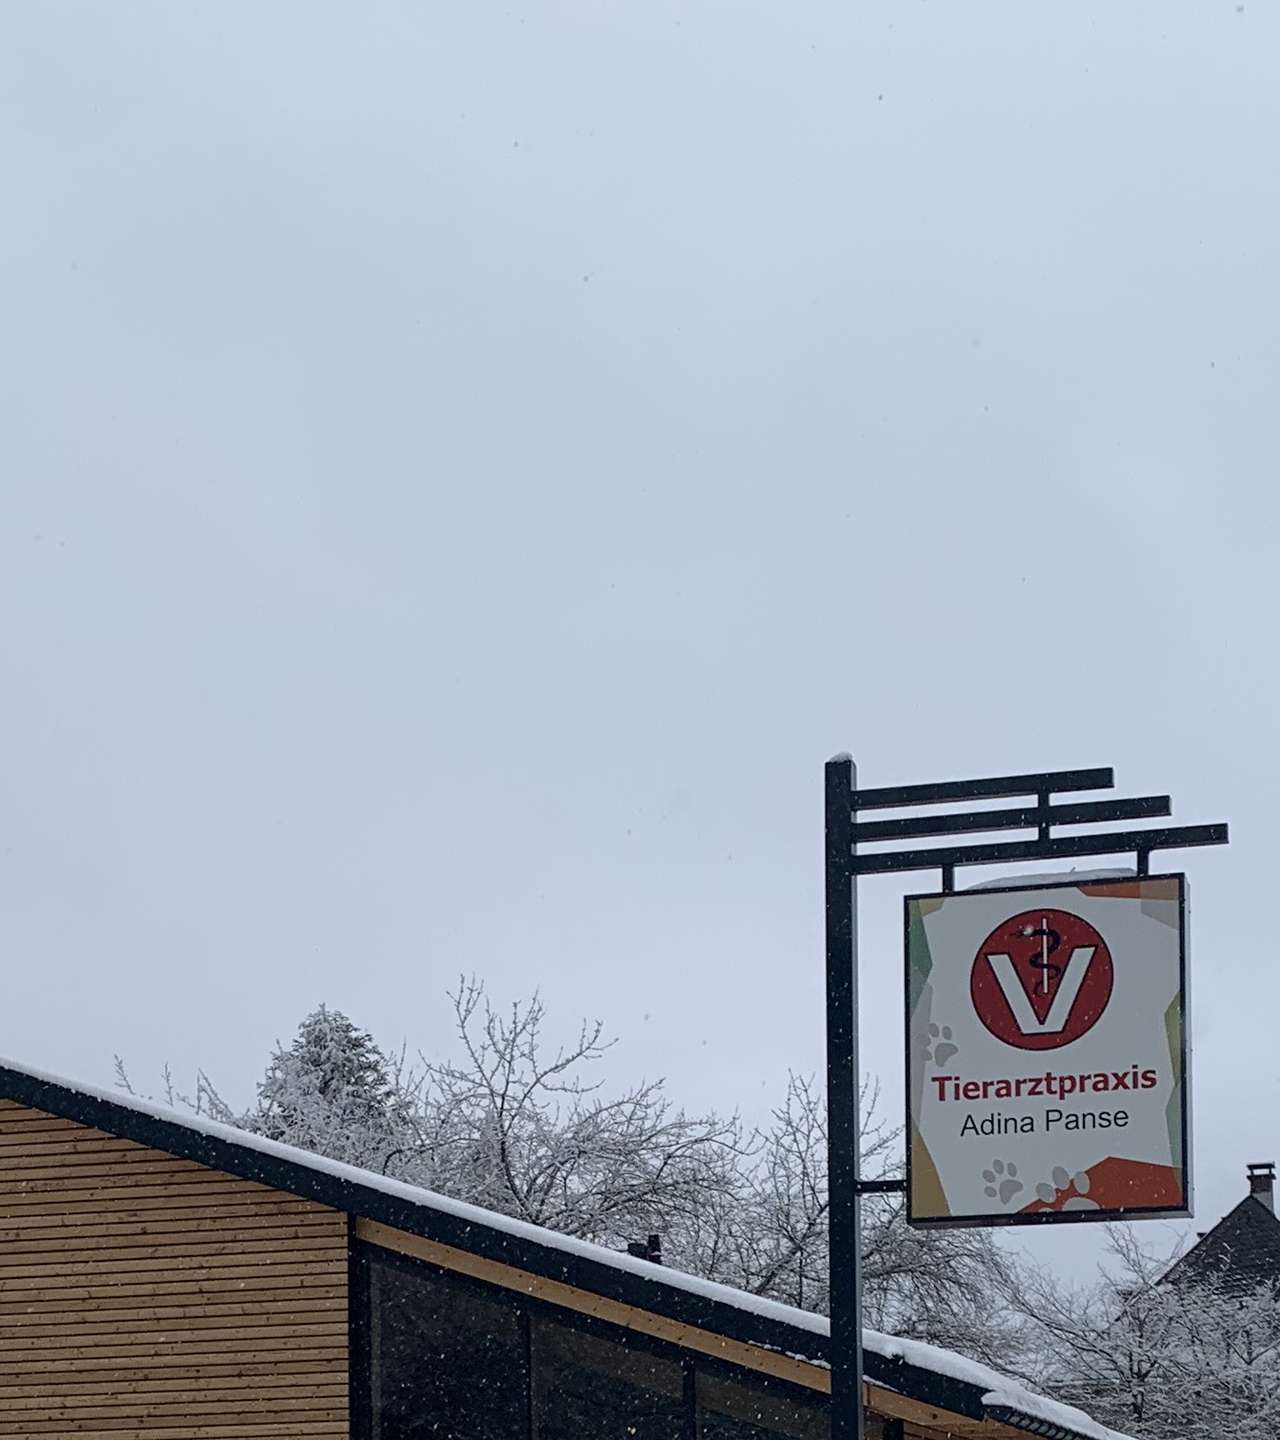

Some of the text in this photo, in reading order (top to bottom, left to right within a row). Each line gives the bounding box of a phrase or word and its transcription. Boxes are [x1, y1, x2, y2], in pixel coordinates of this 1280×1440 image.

[931, 1064, 1158, 1102] Tierarztpraxis
[960, 1109, 1129, 1137] Adina Panse
